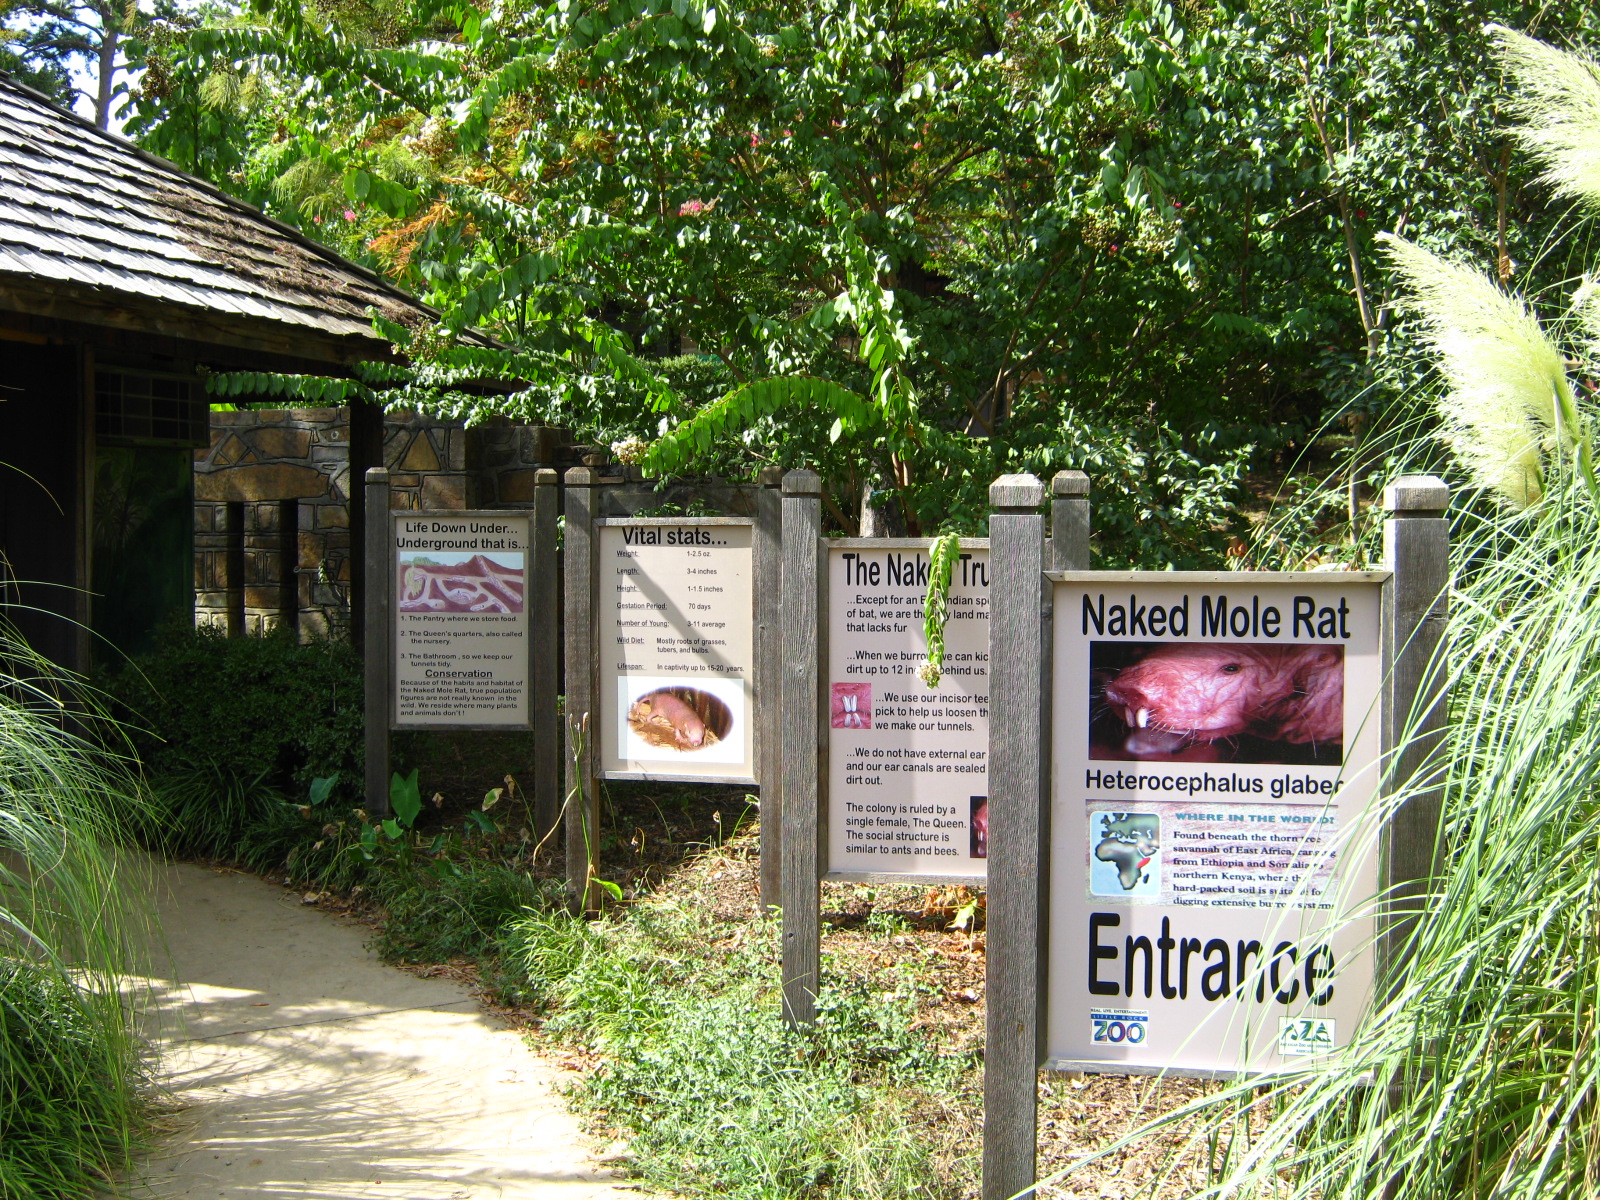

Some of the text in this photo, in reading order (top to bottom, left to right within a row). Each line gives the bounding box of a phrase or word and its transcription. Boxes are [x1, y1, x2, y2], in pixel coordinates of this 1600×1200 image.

[406, 523, 518, 533] Life Down Under...
[622, 527, 727, 545] Vital stats...
[397, 538, 529, 550] Underground that is...
[842, 553, 880, 586] The
[888, 553, 952, 586] Nak
[847, 595, 888, 606] ...Except
[891, 595, 902, 605] for
[906, 597, 917, 605] an
[847, 609, 855, 618] of
[859, 609, 876, 620] bat,
[954, 610, 973, 619] land
[1082, 594, 1350, 639] Naked Mole Rat
[847, 623, 907, 632] that lacks fur
[847, 651, 881, 660] ...When
[955, 653, 972, 661] can
[425, 669, 492, 679] Conservation
[847, 665, 863, 674] dirt
[866, 667, 877, 675] up
[880, 666, 888, 674] to
[892, 665, 902, 674] 12
[876, 693, 898, 702] ...We
[921, 695, 936, 703] our
[940, 694, 972, 703] incisor
[876, 707, 977, 718] pick to help us loosen
[892, 721, 916, 730] make
[938, 722, 974, 731] tunnels.
[847, 748, 869, 757] ...We
[873, 748, 884, 757] do
[887, 749, 901, 757] not
[905, 749, 926, 758] have
[929, 749, 967, 758] external
[847, 762, 863, 770] and
[903, 763, 933, 772] canals
[955, 764, 985, 773] sealed
[846, 776, 882, 785] dirt out.
[1086, 769, 1343, 798] Heterocephalus glaber
[846, 803, 863, 812] The
[866, 803, 896, 815] colony
[900, 804, 907, 812] is
[910, 804, 934, 813] ruled
[937, 805, 947, 816] by
[846, 817, 966, 828] single female, The Queen.
[1175, 813, 1275, 822] WHERE IN THE
[846, 830, 949, 841] The social structure is
[1173, 832, 1297, 842] Found beneath the thorn
[846, 844, 959, 855] similar to ants and bees.
[1223, 846, 1234, 854] of
[1236, 846, 1258, 854] East
[1261, 846, 1294, 856] Africa,
[1173, 858, 1197, 866] from
[1201, 858, 1244, 869] Ethiopia
[1173, 872, 1255, 882] northern Kenya,
[1173, 884, 1234, 894] hard-packed
[1238, 886, 1255, 894] soil
[1258, 886, 1266, 894] is
[1173, 897, 1208, 907] digging
[1212, 899, 1256, 908] extensive
[1088, 912, 1335, 1006] Entrance
[1094, 1021, 1145, 1043] ZOO
